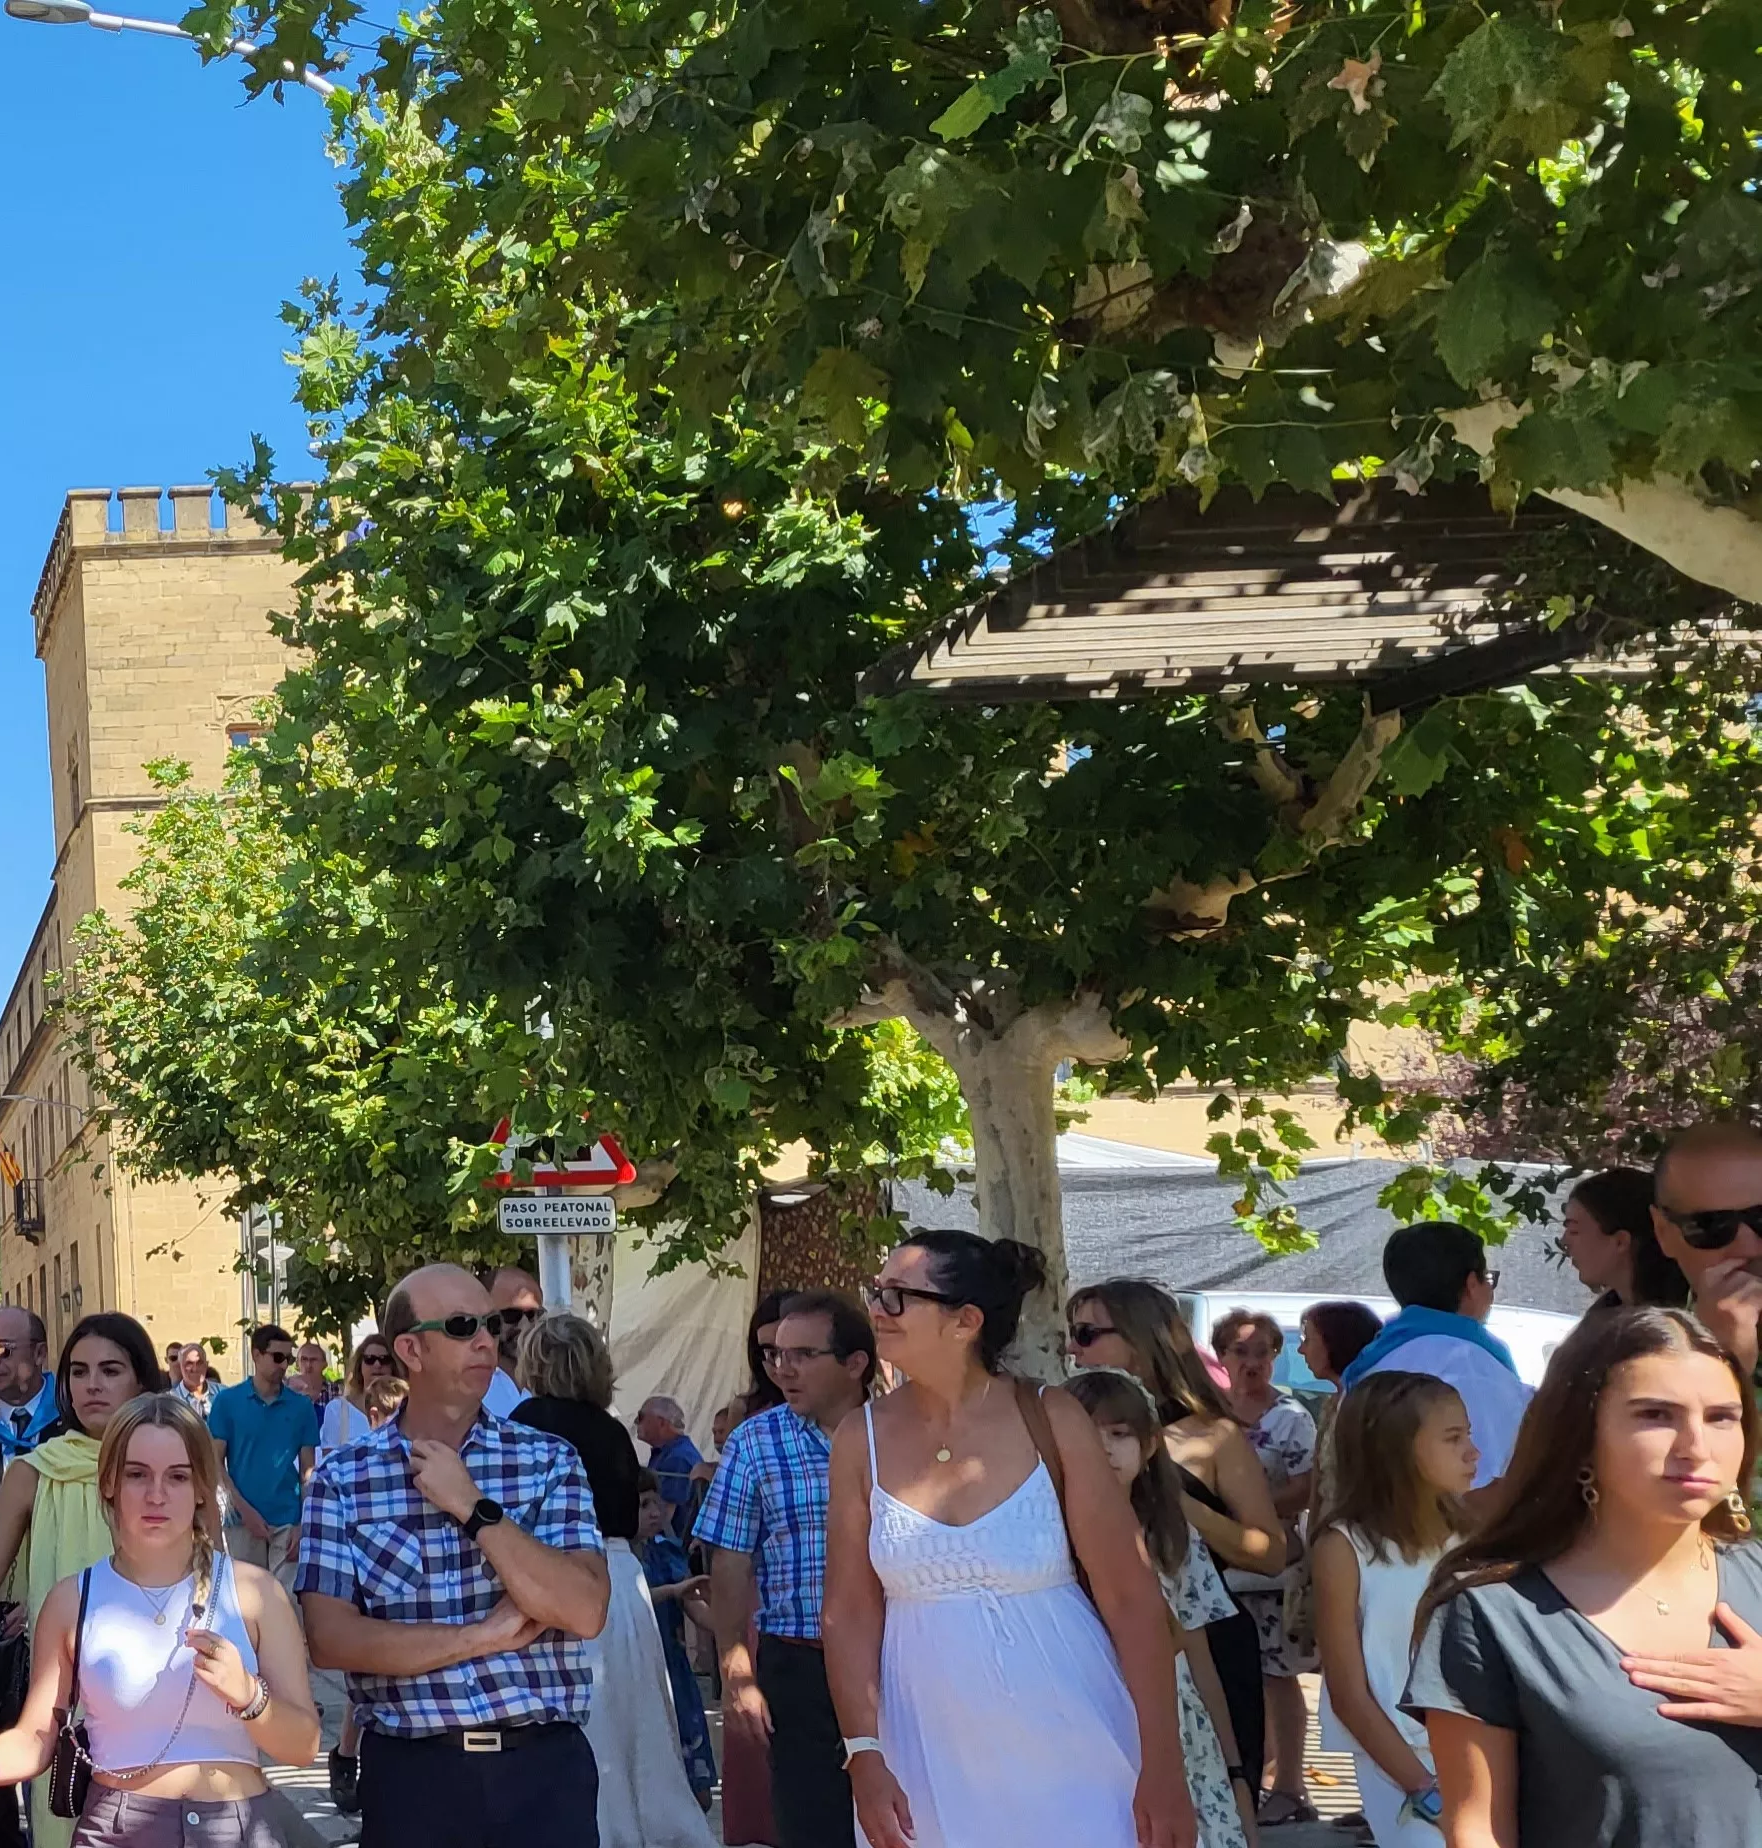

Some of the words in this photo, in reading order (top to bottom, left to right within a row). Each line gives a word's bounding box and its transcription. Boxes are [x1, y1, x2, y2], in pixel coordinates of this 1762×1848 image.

[503, 1203, 538, 1213] PASO
[544, 1202, 611, 1213] PEATONAL
[505, 1217, 611, 1228] SOBREELEVADO
